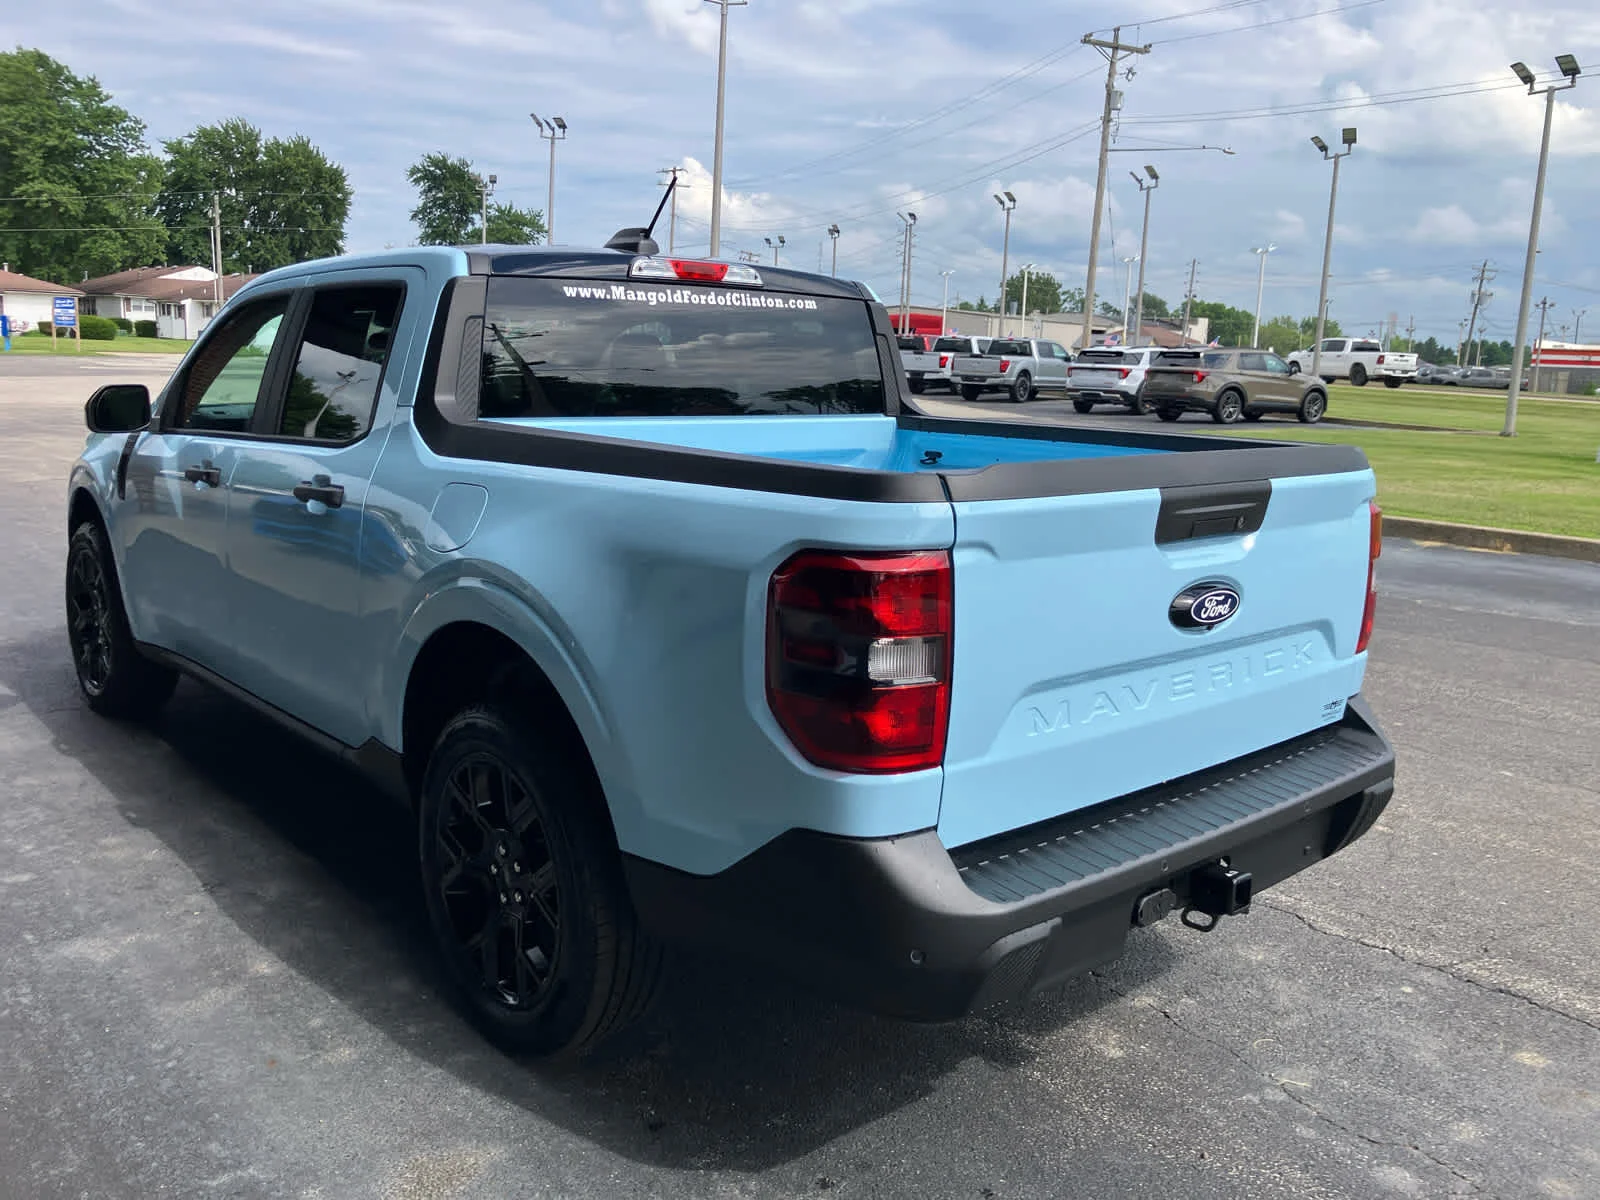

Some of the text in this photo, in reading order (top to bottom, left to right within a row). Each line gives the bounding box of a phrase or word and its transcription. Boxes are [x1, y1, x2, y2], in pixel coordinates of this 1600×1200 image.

[563, 285, 818, 310] www.MangoldFordofClinton.com
[1200, 594, 1232, 619] Ford
[1026, 639, 1315, 737] MAVERICK
